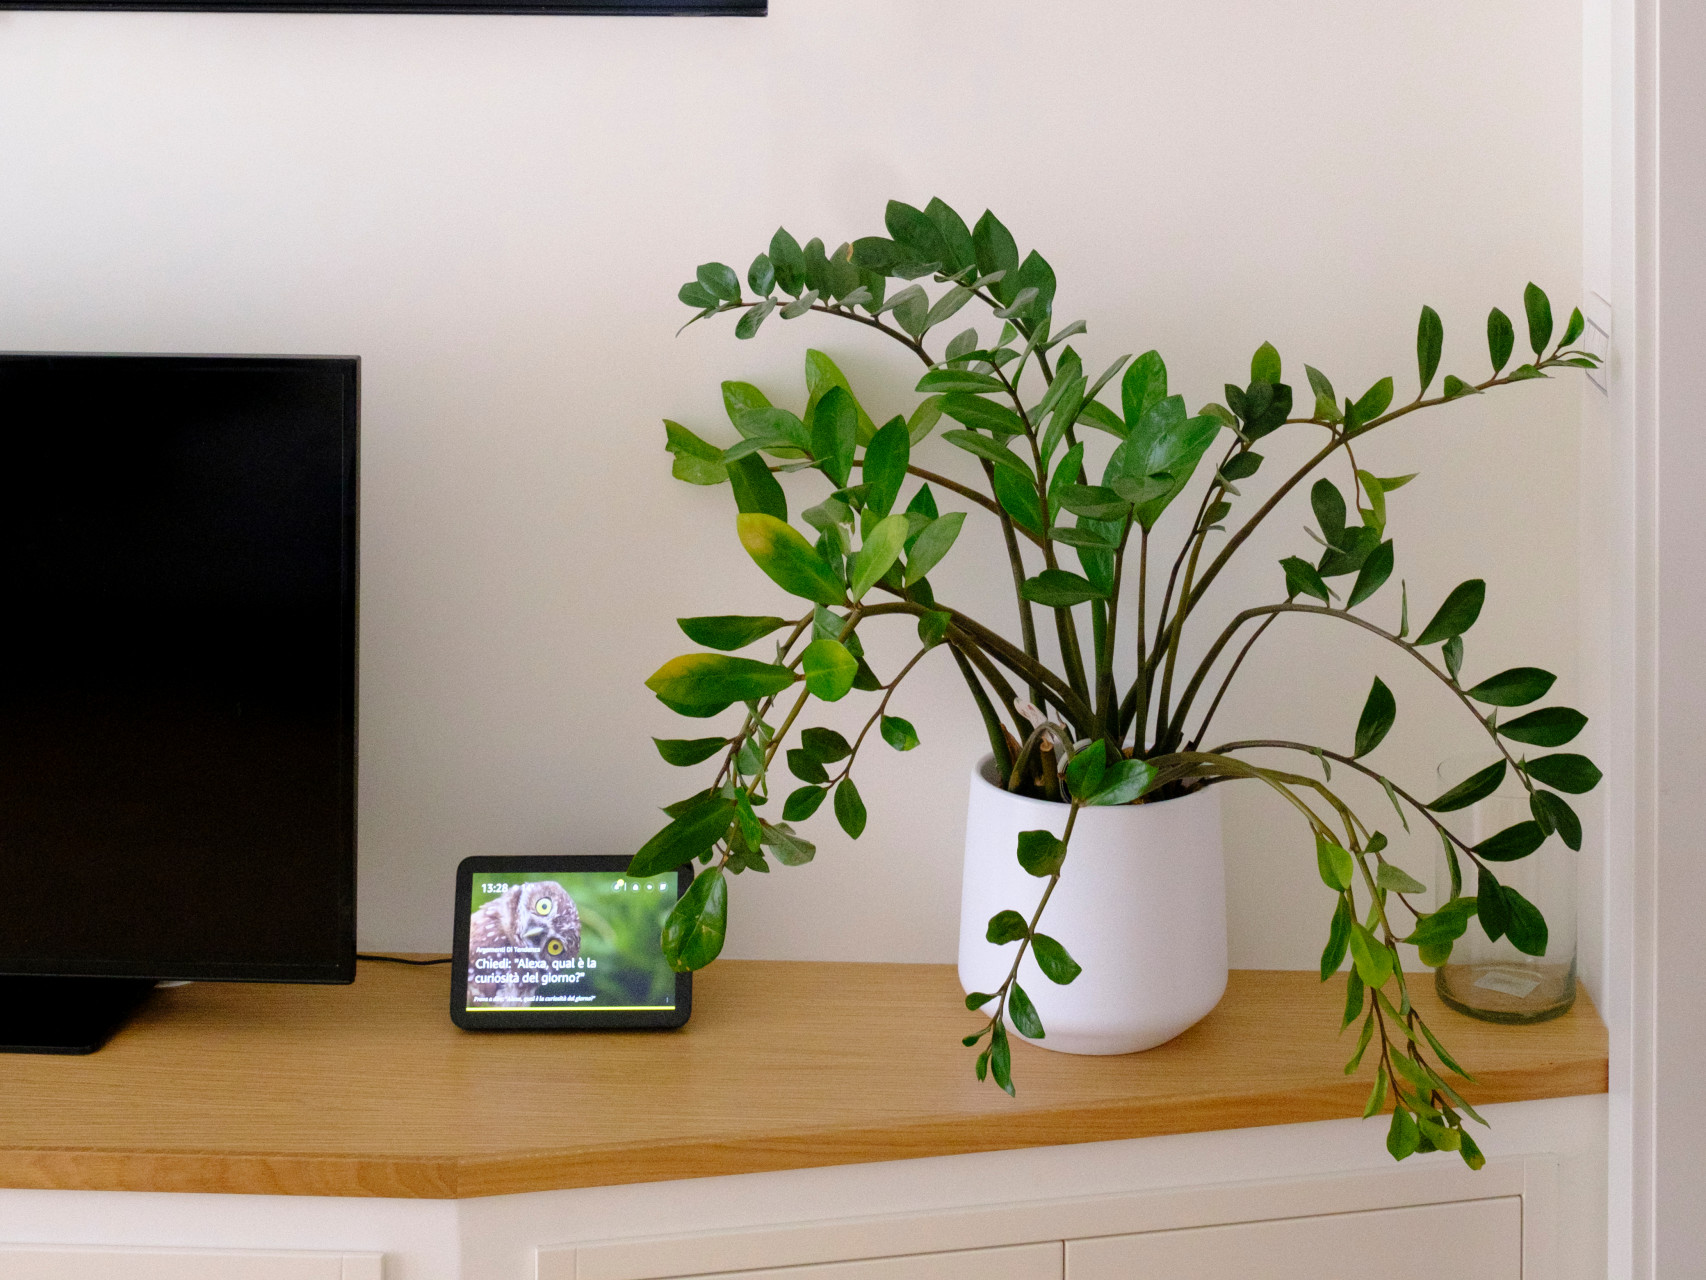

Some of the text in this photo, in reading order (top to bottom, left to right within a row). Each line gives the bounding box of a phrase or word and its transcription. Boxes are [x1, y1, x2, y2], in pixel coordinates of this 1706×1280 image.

[481, 883, 509, 893] 13:28
[475, 957, 597, 970] Chiedi: "Alexa, qual è la
[474, 971, 585, 986] curiosità del giorno?"
